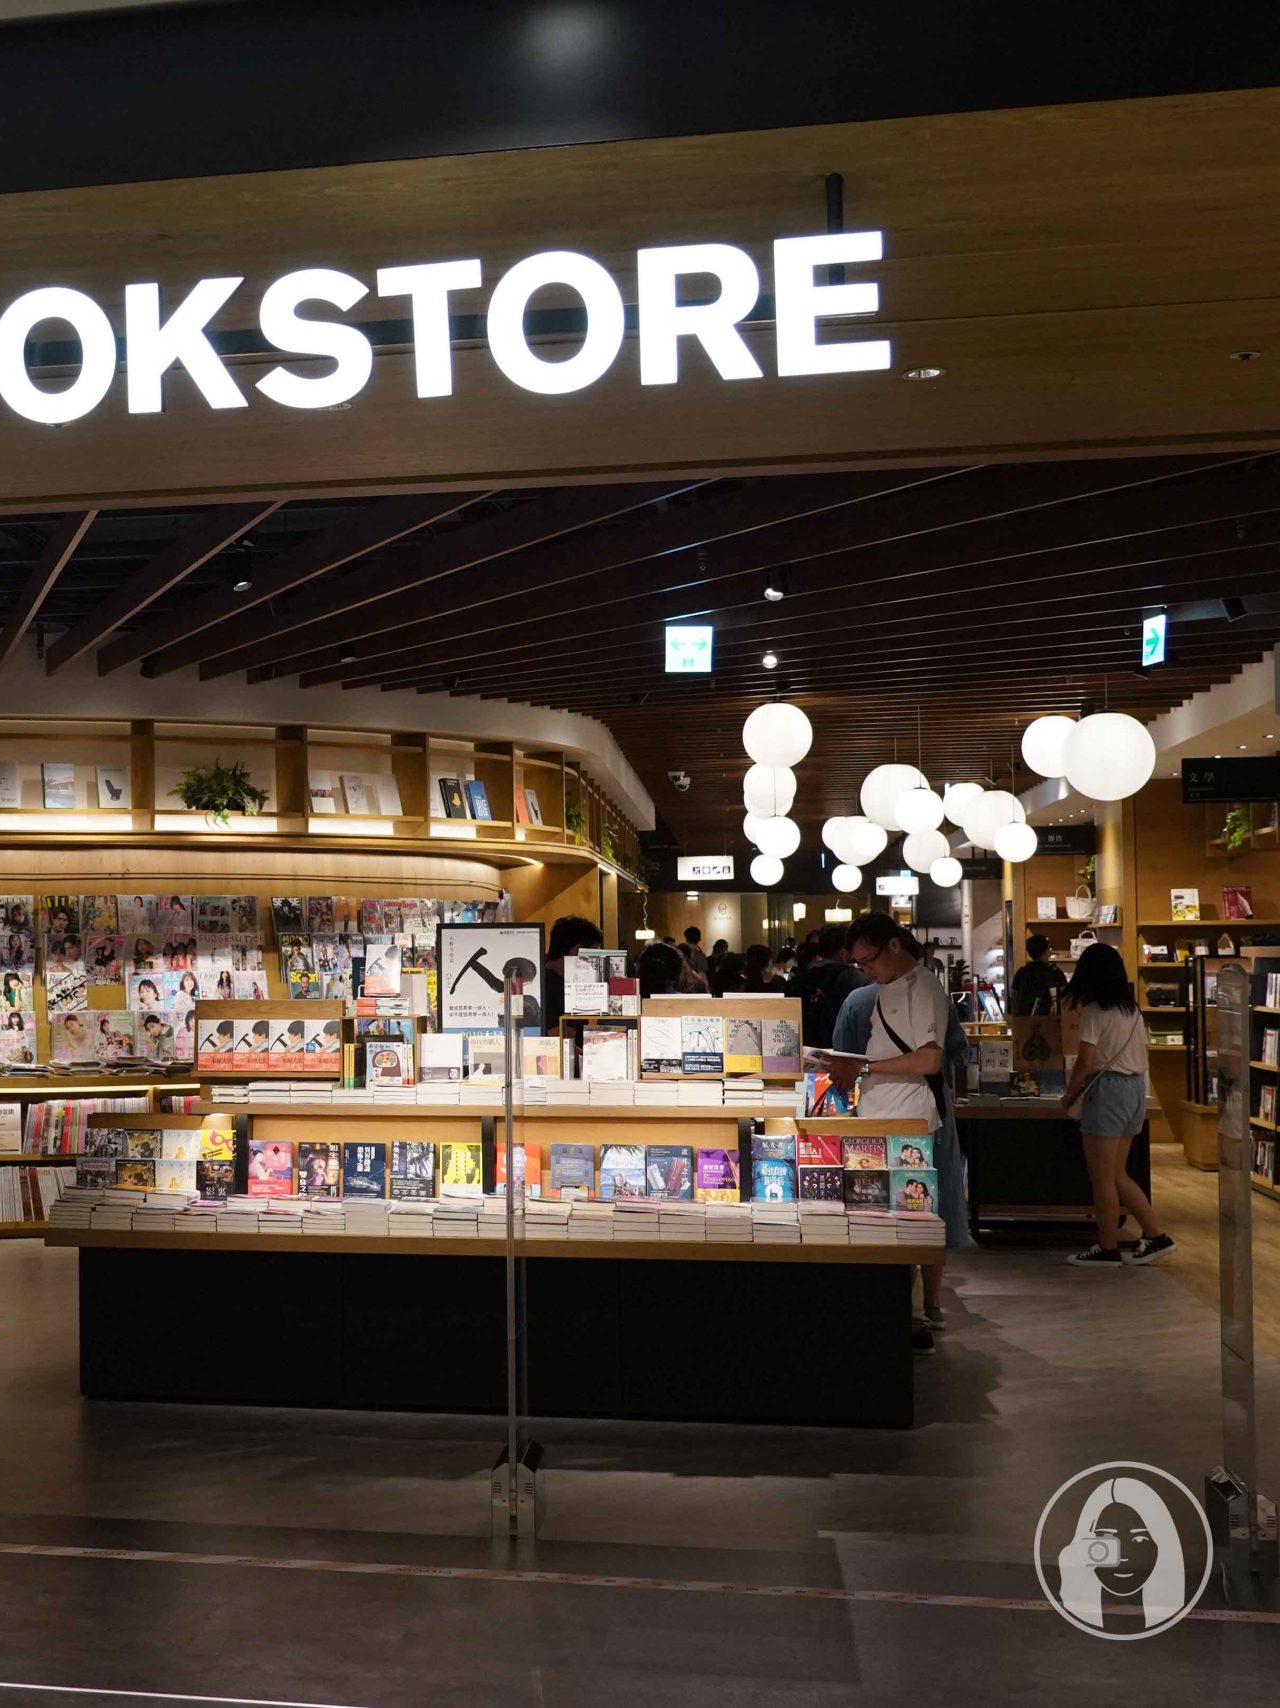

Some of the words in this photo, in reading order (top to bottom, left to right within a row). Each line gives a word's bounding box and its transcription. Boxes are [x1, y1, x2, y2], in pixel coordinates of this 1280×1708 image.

[475, 799, 486, 810] BIKE
[477, 808, 489, 817] BOOK
[272, 897, 300, 907] SESE
[843, 1144, 886, 1153] MARTIN
